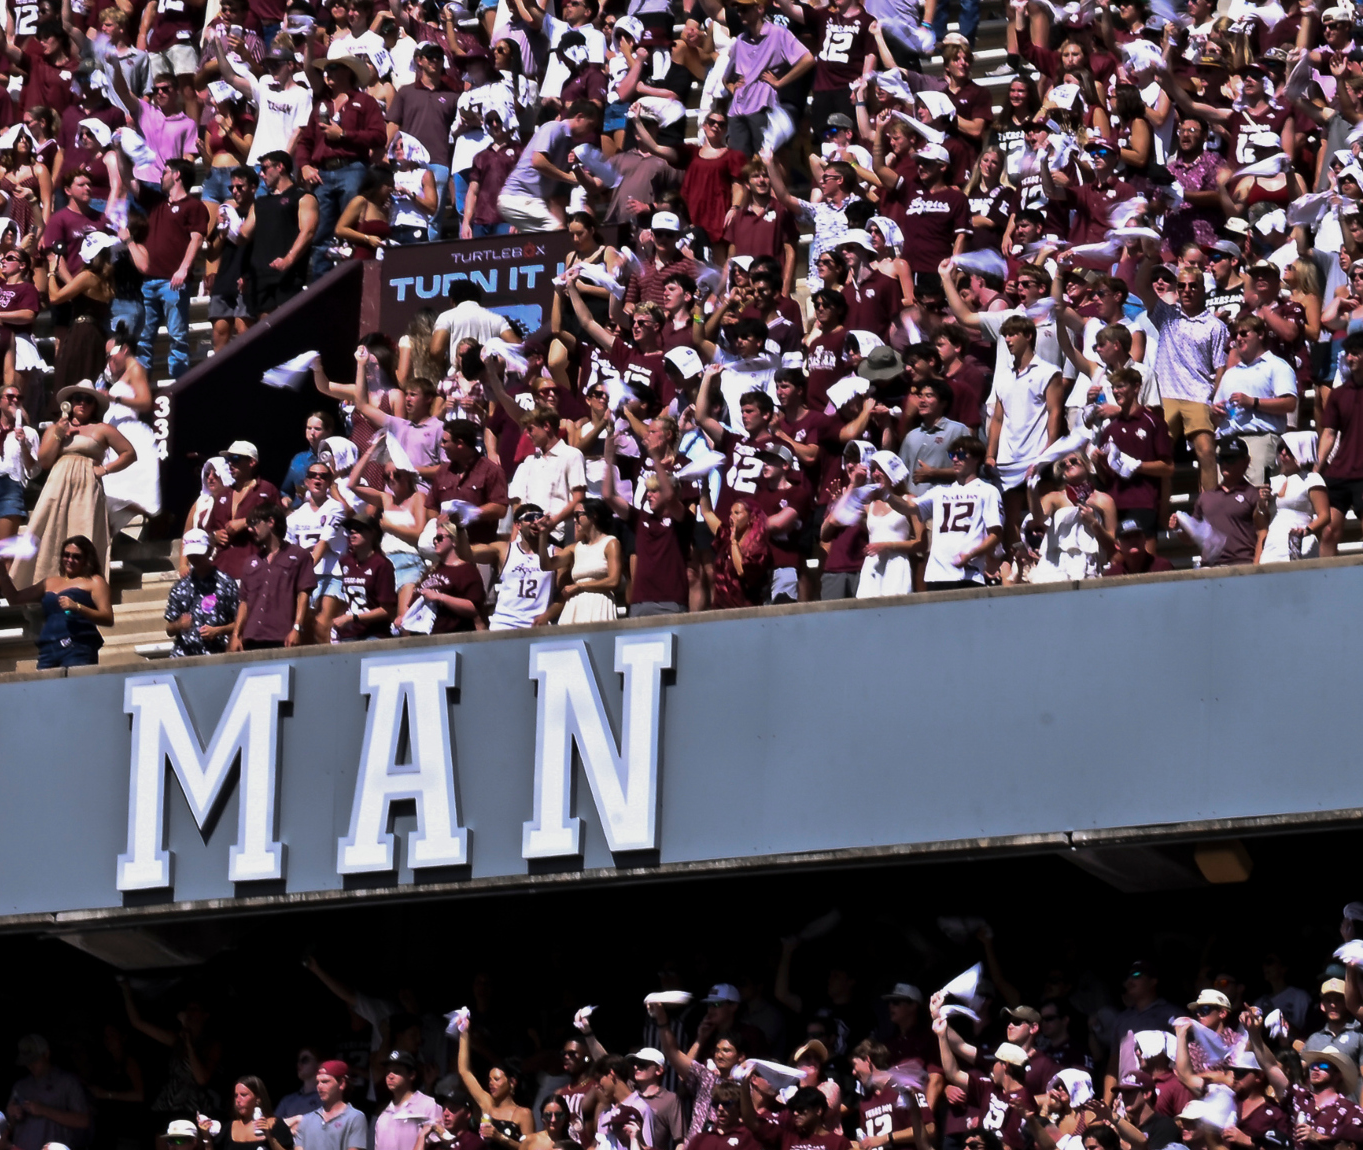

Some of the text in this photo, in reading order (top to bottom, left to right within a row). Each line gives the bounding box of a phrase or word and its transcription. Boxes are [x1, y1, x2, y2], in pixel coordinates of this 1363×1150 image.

[13, 7, 38, 35] 12
[819, 39, 851, 67] 12
[508, 264, 544, 291] IT
[154, 396, 171, 459] 334
[941, 502, 974, 532] 12
[518, 579, 537, 598] 12
[116, 631, 674, 892] MAN
